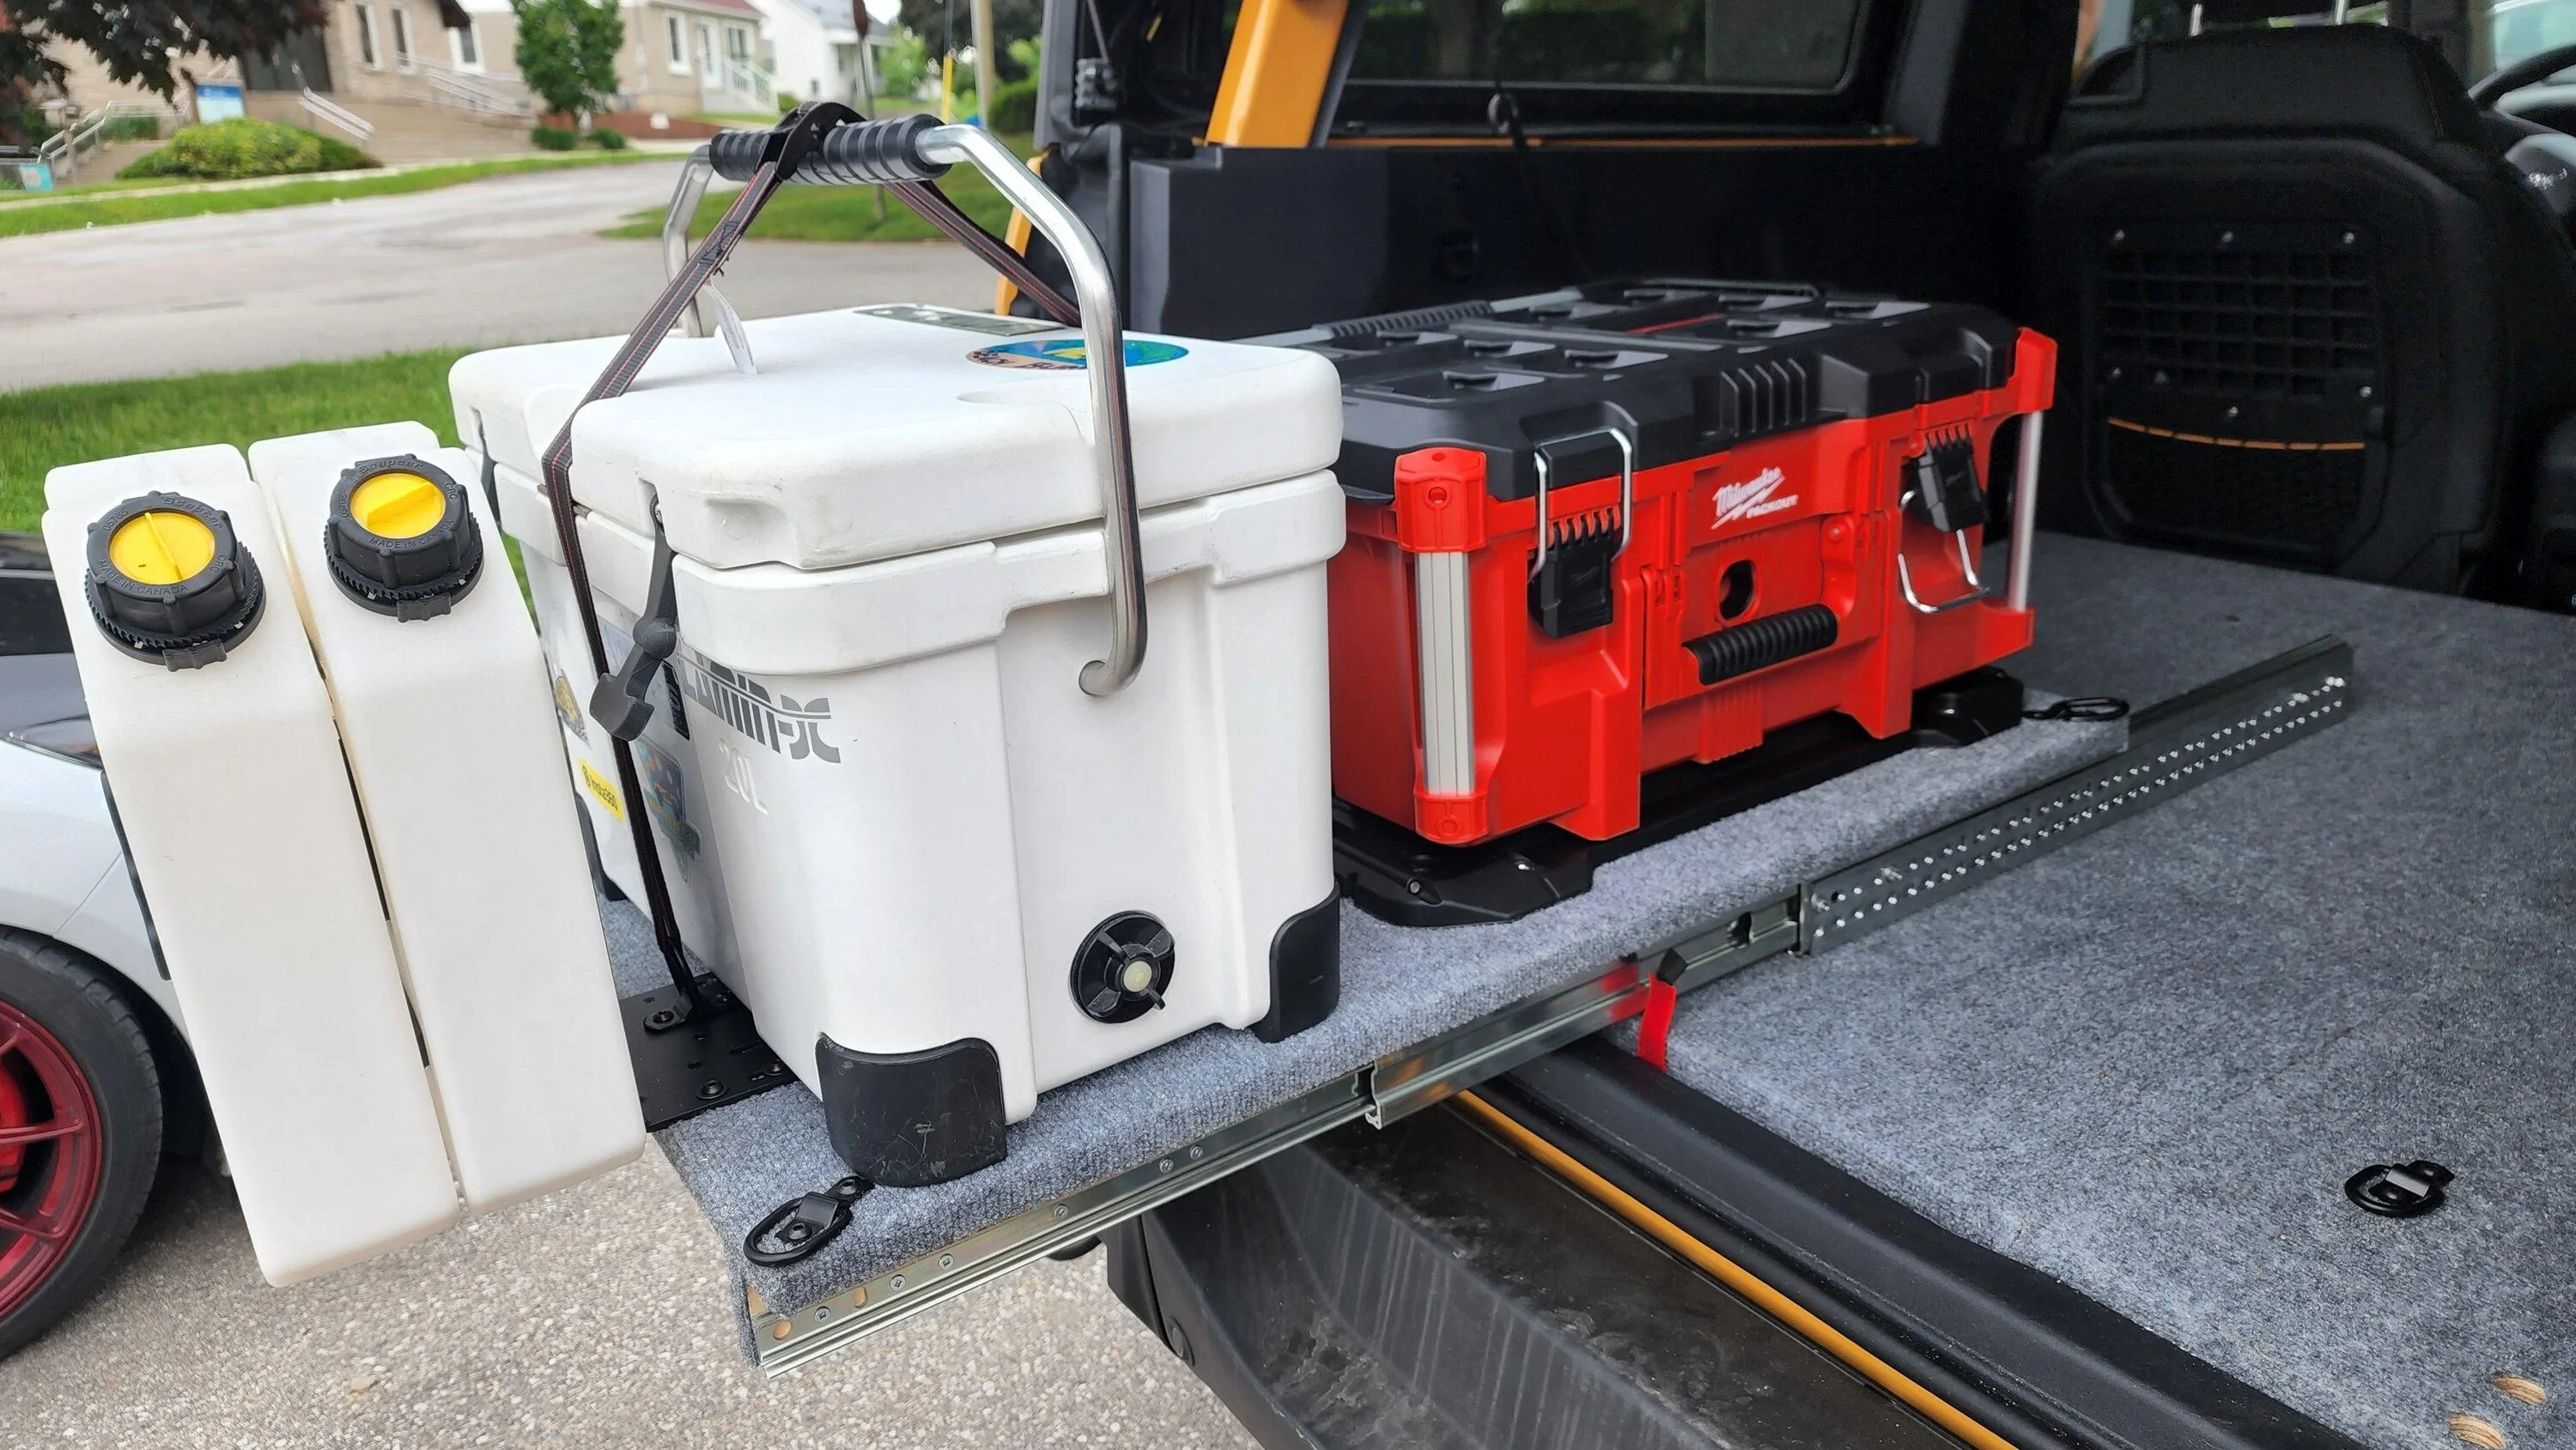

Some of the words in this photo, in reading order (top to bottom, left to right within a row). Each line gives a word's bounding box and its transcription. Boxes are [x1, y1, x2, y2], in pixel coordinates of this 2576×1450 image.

[1712, 466, 1783, 517] Milwaukee
[162, 494, 222, 531] Scepter
[368, 537, 401, 549] MADE
[404, 540, 416, 549] IN
[96, 559, 120, 585] MADE
[121, 579, 134, 592] IN
[137, 584, 189, 596] CANADA
[718, 737, 769, 816] 20L
